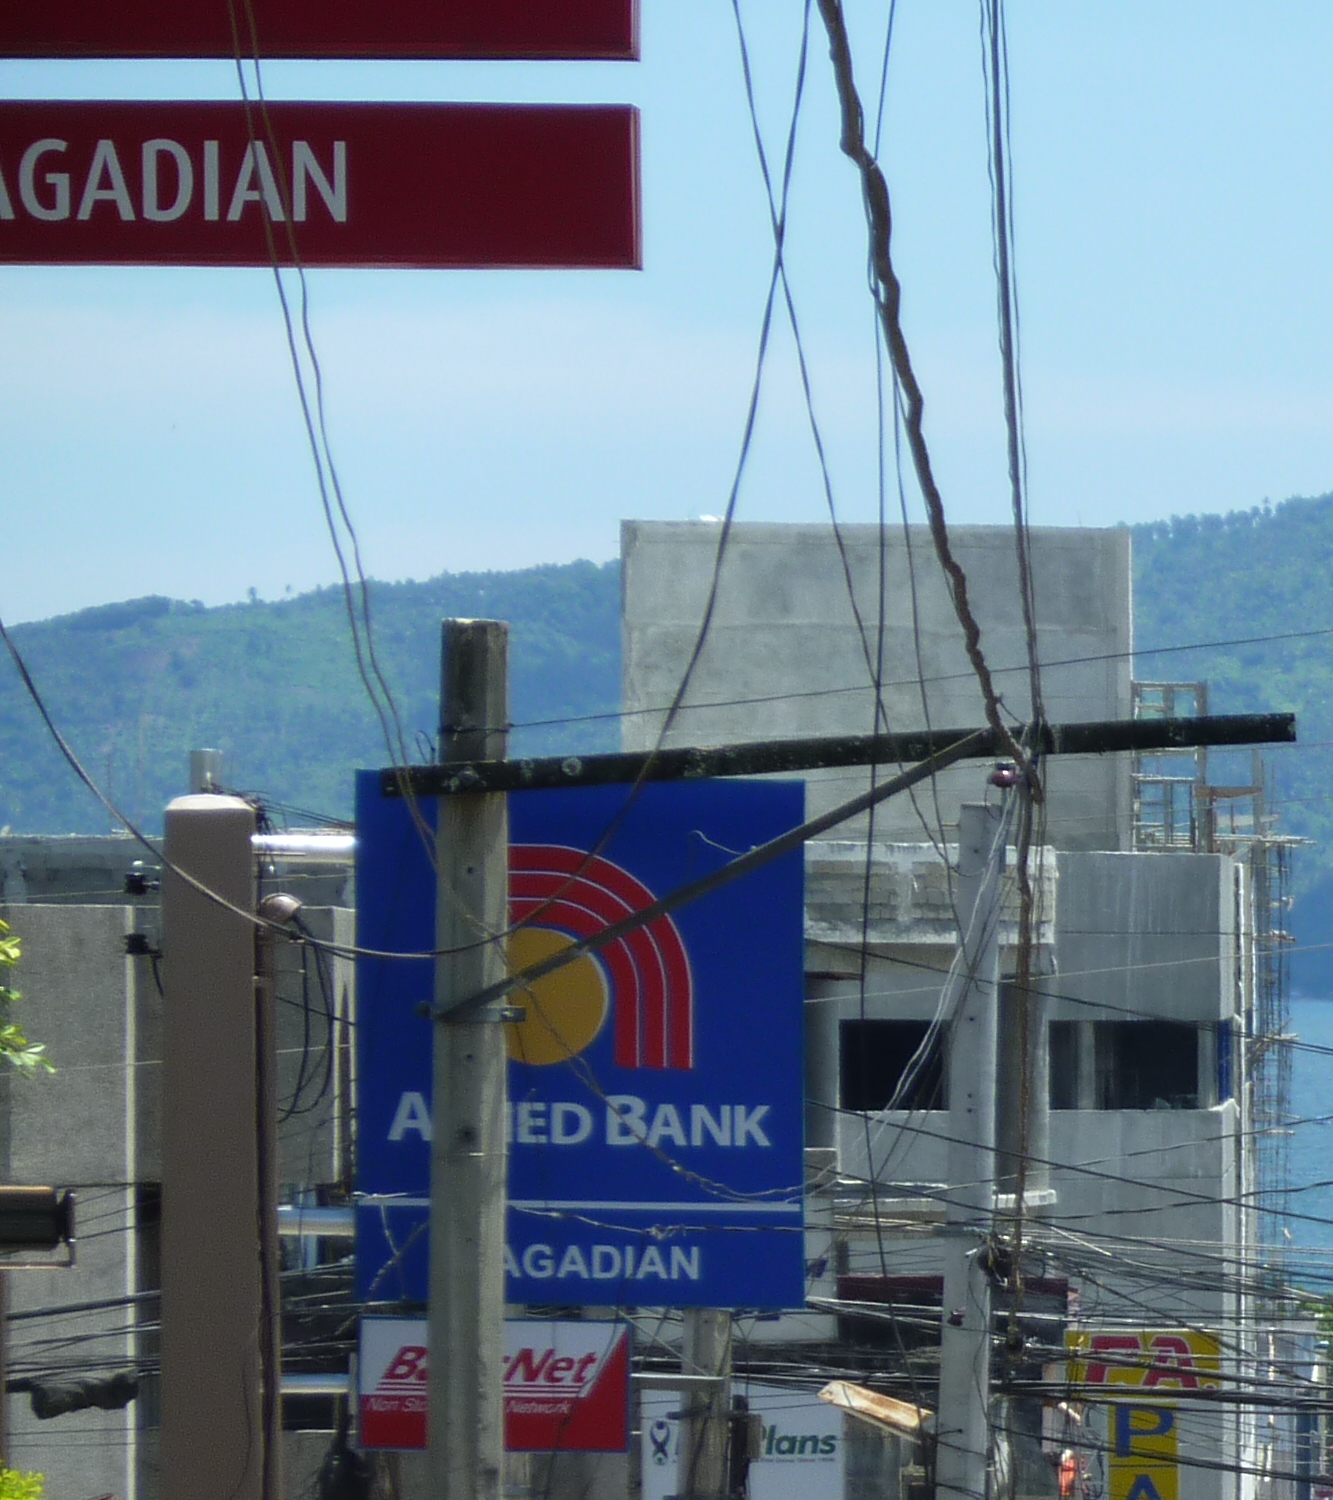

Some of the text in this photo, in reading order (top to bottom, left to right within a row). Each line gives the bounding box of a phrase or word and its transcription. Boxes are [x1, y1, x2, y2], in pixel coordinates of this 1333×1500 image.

[0, 139, 348, 222] GADIAN
[387, 1090, 772, 1148] AIED BANK
[760, 1423, 837, 1456] lans
